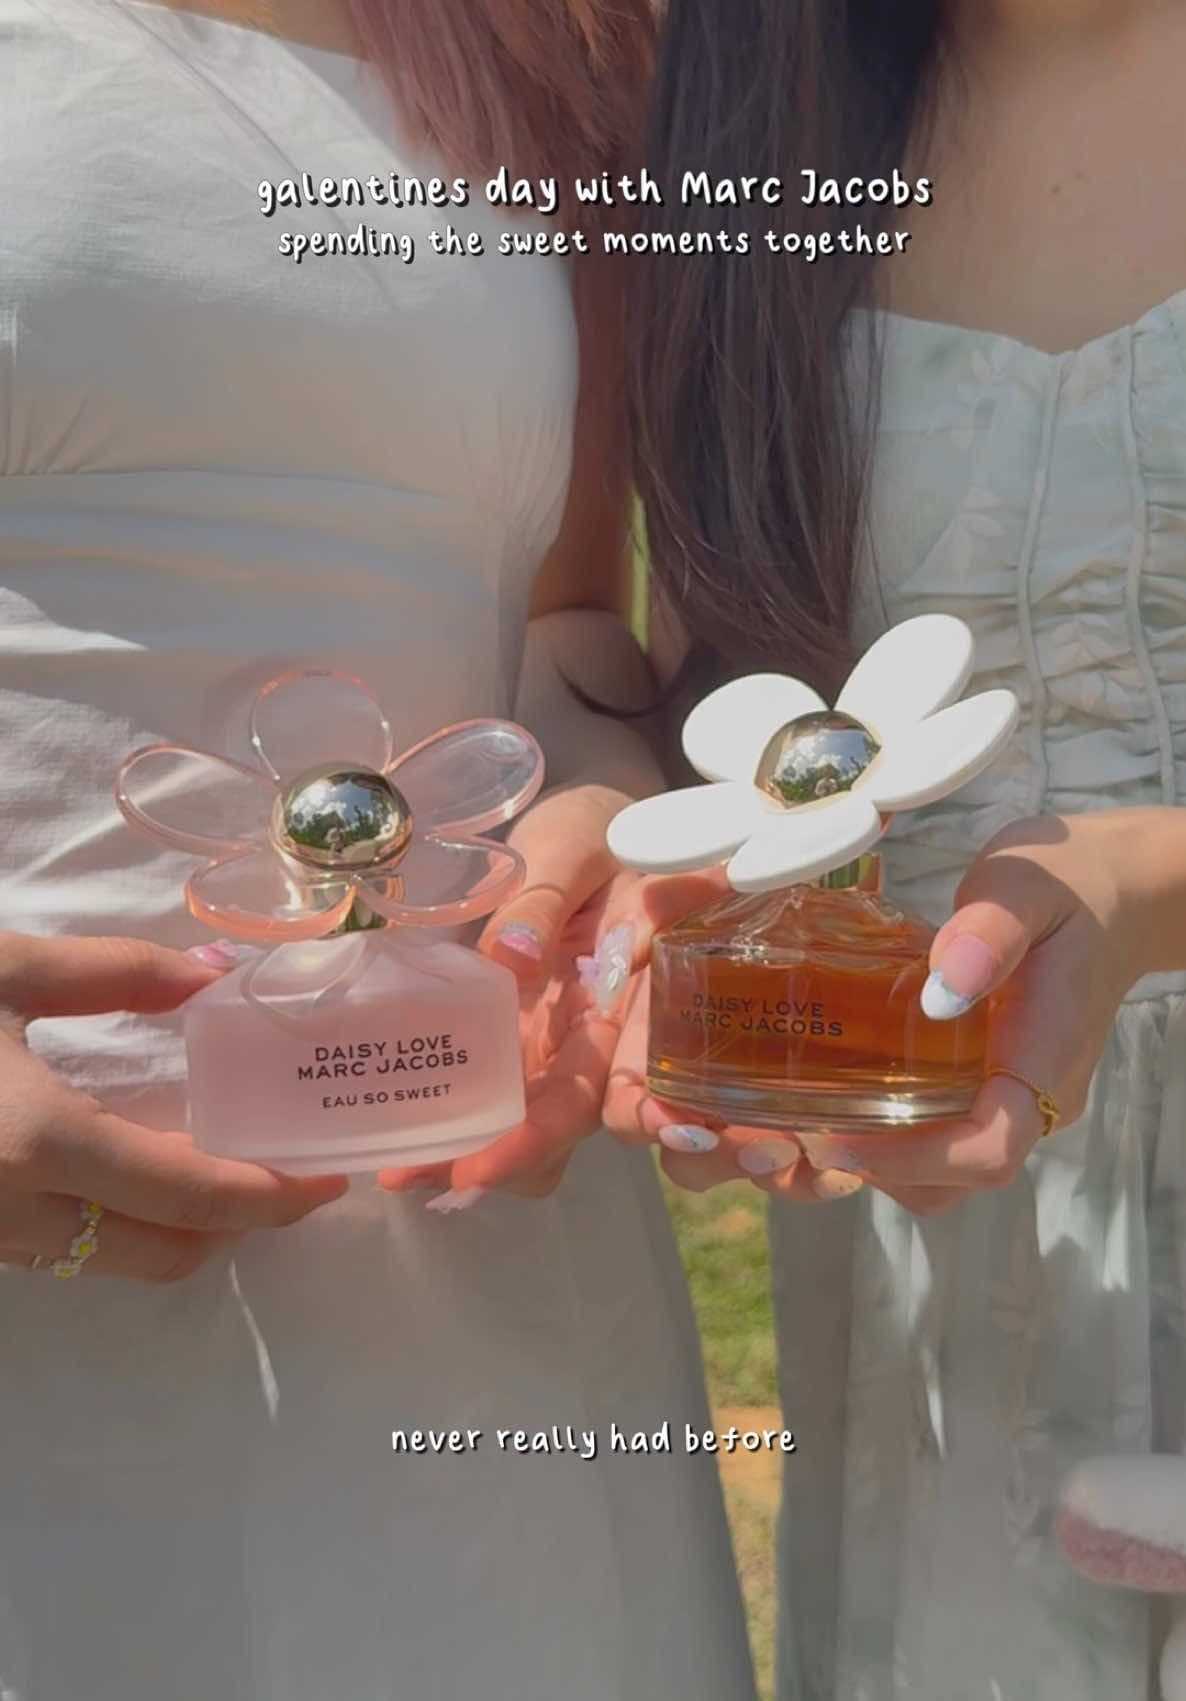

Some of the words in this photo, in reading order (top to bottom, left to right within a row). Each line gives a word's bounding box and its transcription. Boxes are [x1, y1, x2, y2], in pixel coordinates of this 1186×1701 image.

[693, 993, 751, 1012] DAISY
[763, 1000, 824, 1017] LOVE
[680, 1010, 731, 1028] MARC
[742, 1017, 843, 1036] JACOBS
[315, 1042, 387, 1062] DAISY
[397, 1034, 452, 1054] LOVE
[298, 1061, 366, 1080] MARC
[376, 1049, 468, 1074] JACOBS
[322, 1095, 358, 1109] EAU
[363, 1091, 389, 1105] SO
[393, 1083, 452, 1102] SWEET
